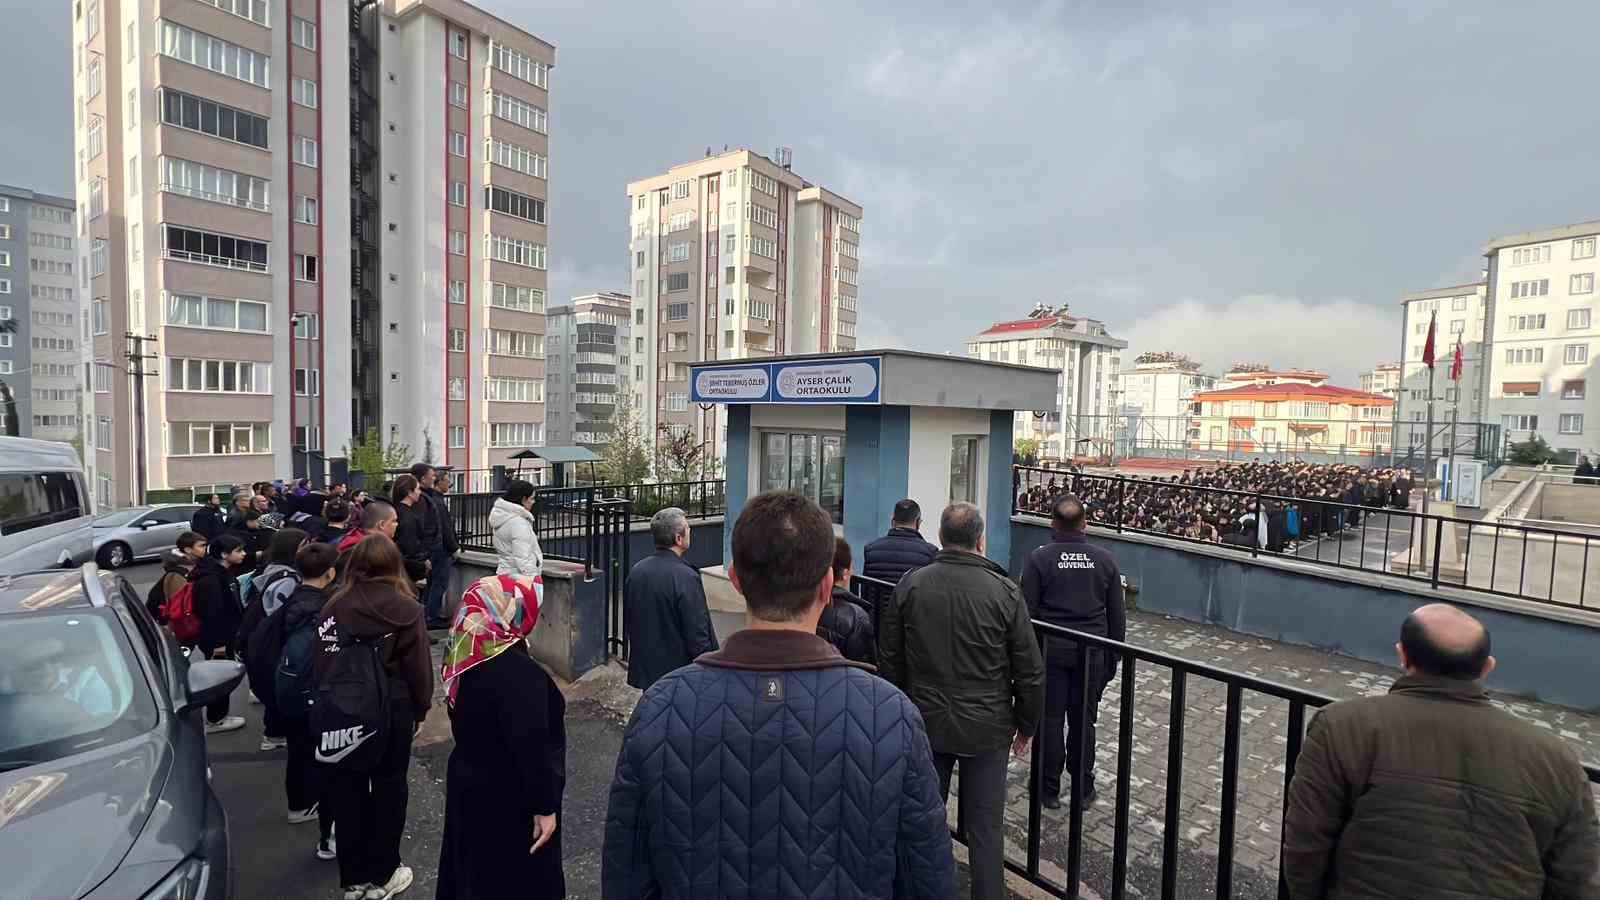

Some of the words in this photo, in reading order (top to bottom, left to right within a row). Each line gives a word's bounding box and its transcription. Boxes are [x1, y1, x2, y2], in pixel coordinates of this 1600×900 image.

[797, 377, 823, 386] AYSER
[825, 376, 852, 386] ÇALIK
[709, 387, 737, 395] ORTAOKULU
[797, 386, 851, 395] ORTAOKULU
[1060, 551, 1091, 561] ÖZEL
[1057, 561, 1095, 569] GÜVENLİK
[321, 725, 364, 752] NIKE
